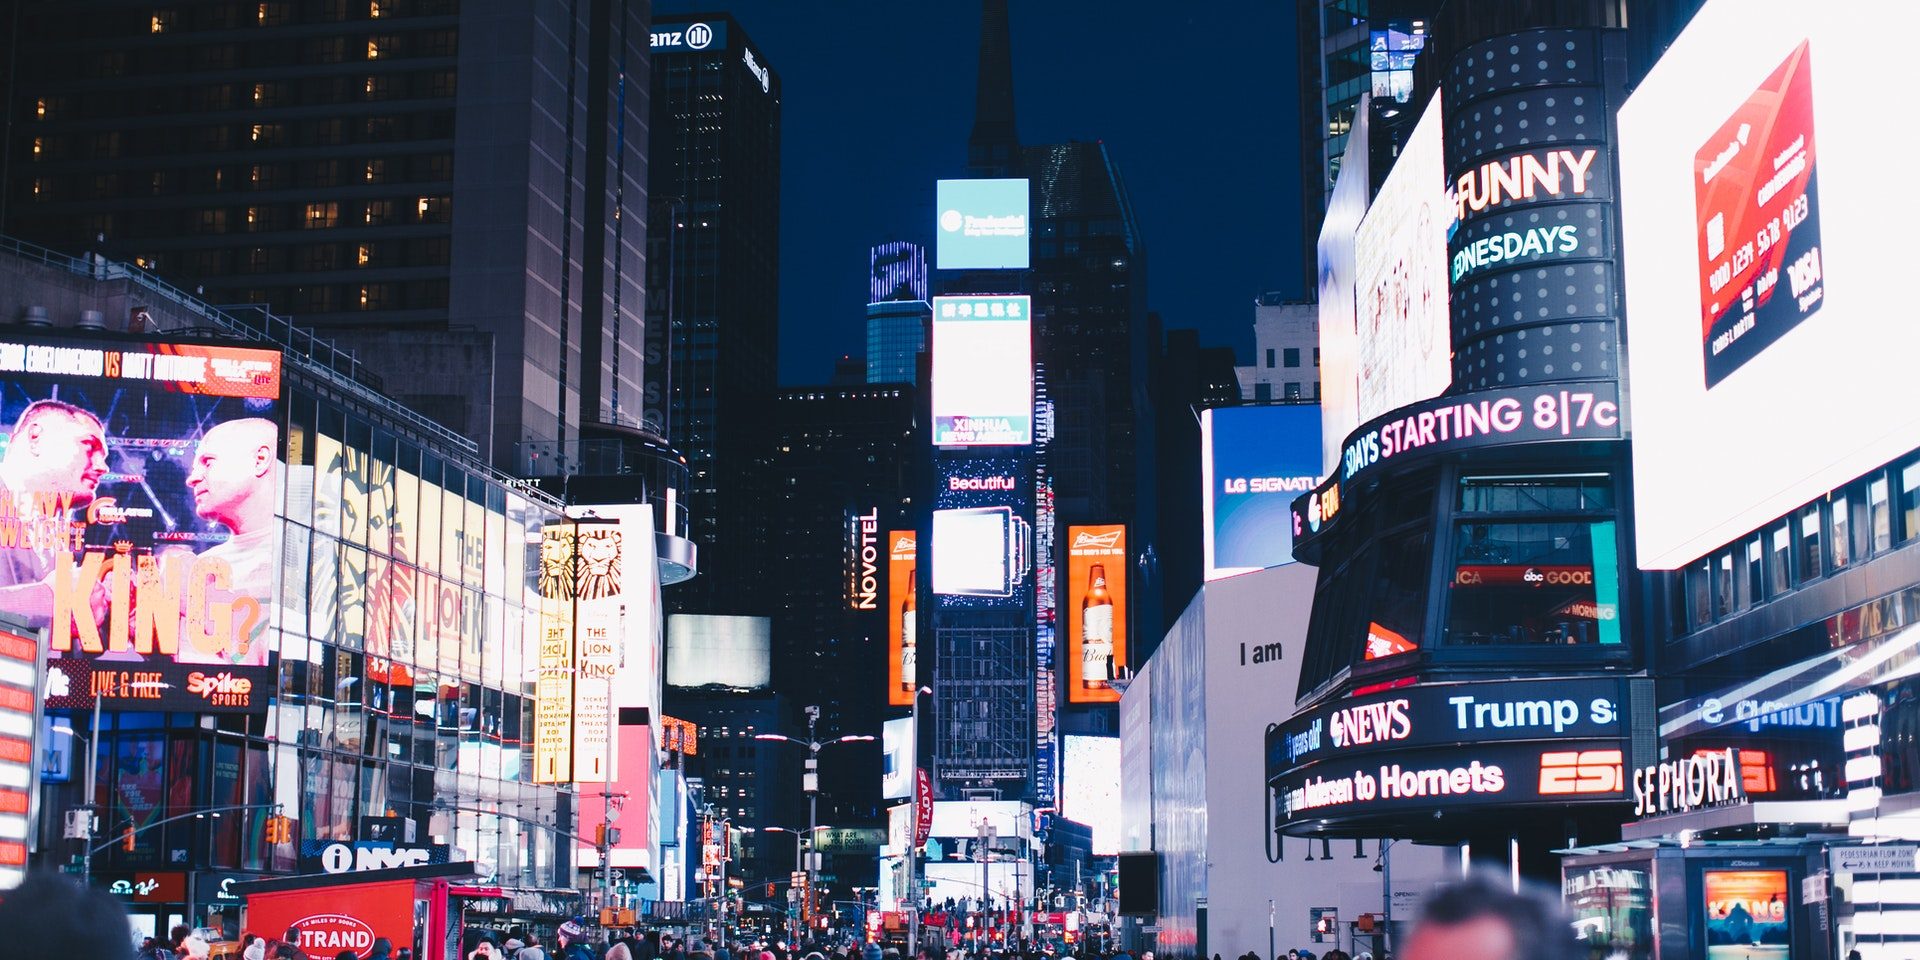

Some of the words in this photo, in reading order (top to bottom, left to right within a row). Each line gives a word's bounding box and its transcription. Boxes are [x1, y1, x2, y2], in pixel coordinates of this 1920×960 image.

[650, 32, 682, 47] anz
[1457, 150, 1596, 220] FUNNY
[1452, 225, 1579, 284] EDNESDAYS
[1787, 247, 1822, 299] VISA
[105, 351, 120, 378] VS
[953, 417, 1012, 432] XINHUA
[1381, 397, 1523, 459] STARTING
[949, 475, 1015, 490] Beautiful
[1224, 478, 1248, 494] LG
[455, 529, 483, 570] THE
[859, 506, 878, 610] NOVOTEL
[1523, 571, 1544, 583] abc
[1571, 604, 1616, 621] MORNING
[586, 627, 607, 638] THE
[582, 640, 612, 658] LION
[1240, 642, 1246, 666] I
[1252, 642, 1283, 664] am
[580, 659, 616, 680] KING
[90, 670, 116, 698] LIVE
[132, 672, 162, 699] FREE
[187, 671, 252, 699] Spike
[211, 694, 250, 707] SPORTS
[1341, 699, 1412, 747] NEWS
[1449, 695, 1579, 733] Trump
[1291, 732, 1308, 764] years
[1304, 775, 1353, 809] Andersen
[1354, 770, 1377, 801] to
[1380, 761, 1506, 799] Hornets
[1633, 746, 1739, 816] SEPHORA
[825, 831, 843, 839] WHAT
[845, 831, 857, 839] ARE
[356, 846, 430, 871] NYC
[1840, 850, 1878, 859] PEDESTRIAN
[1880, 850, 1897, 858] FLOW
[1898, 849, 1914, 857] ZONE
[338, 918, 357, 928] BOOKS
